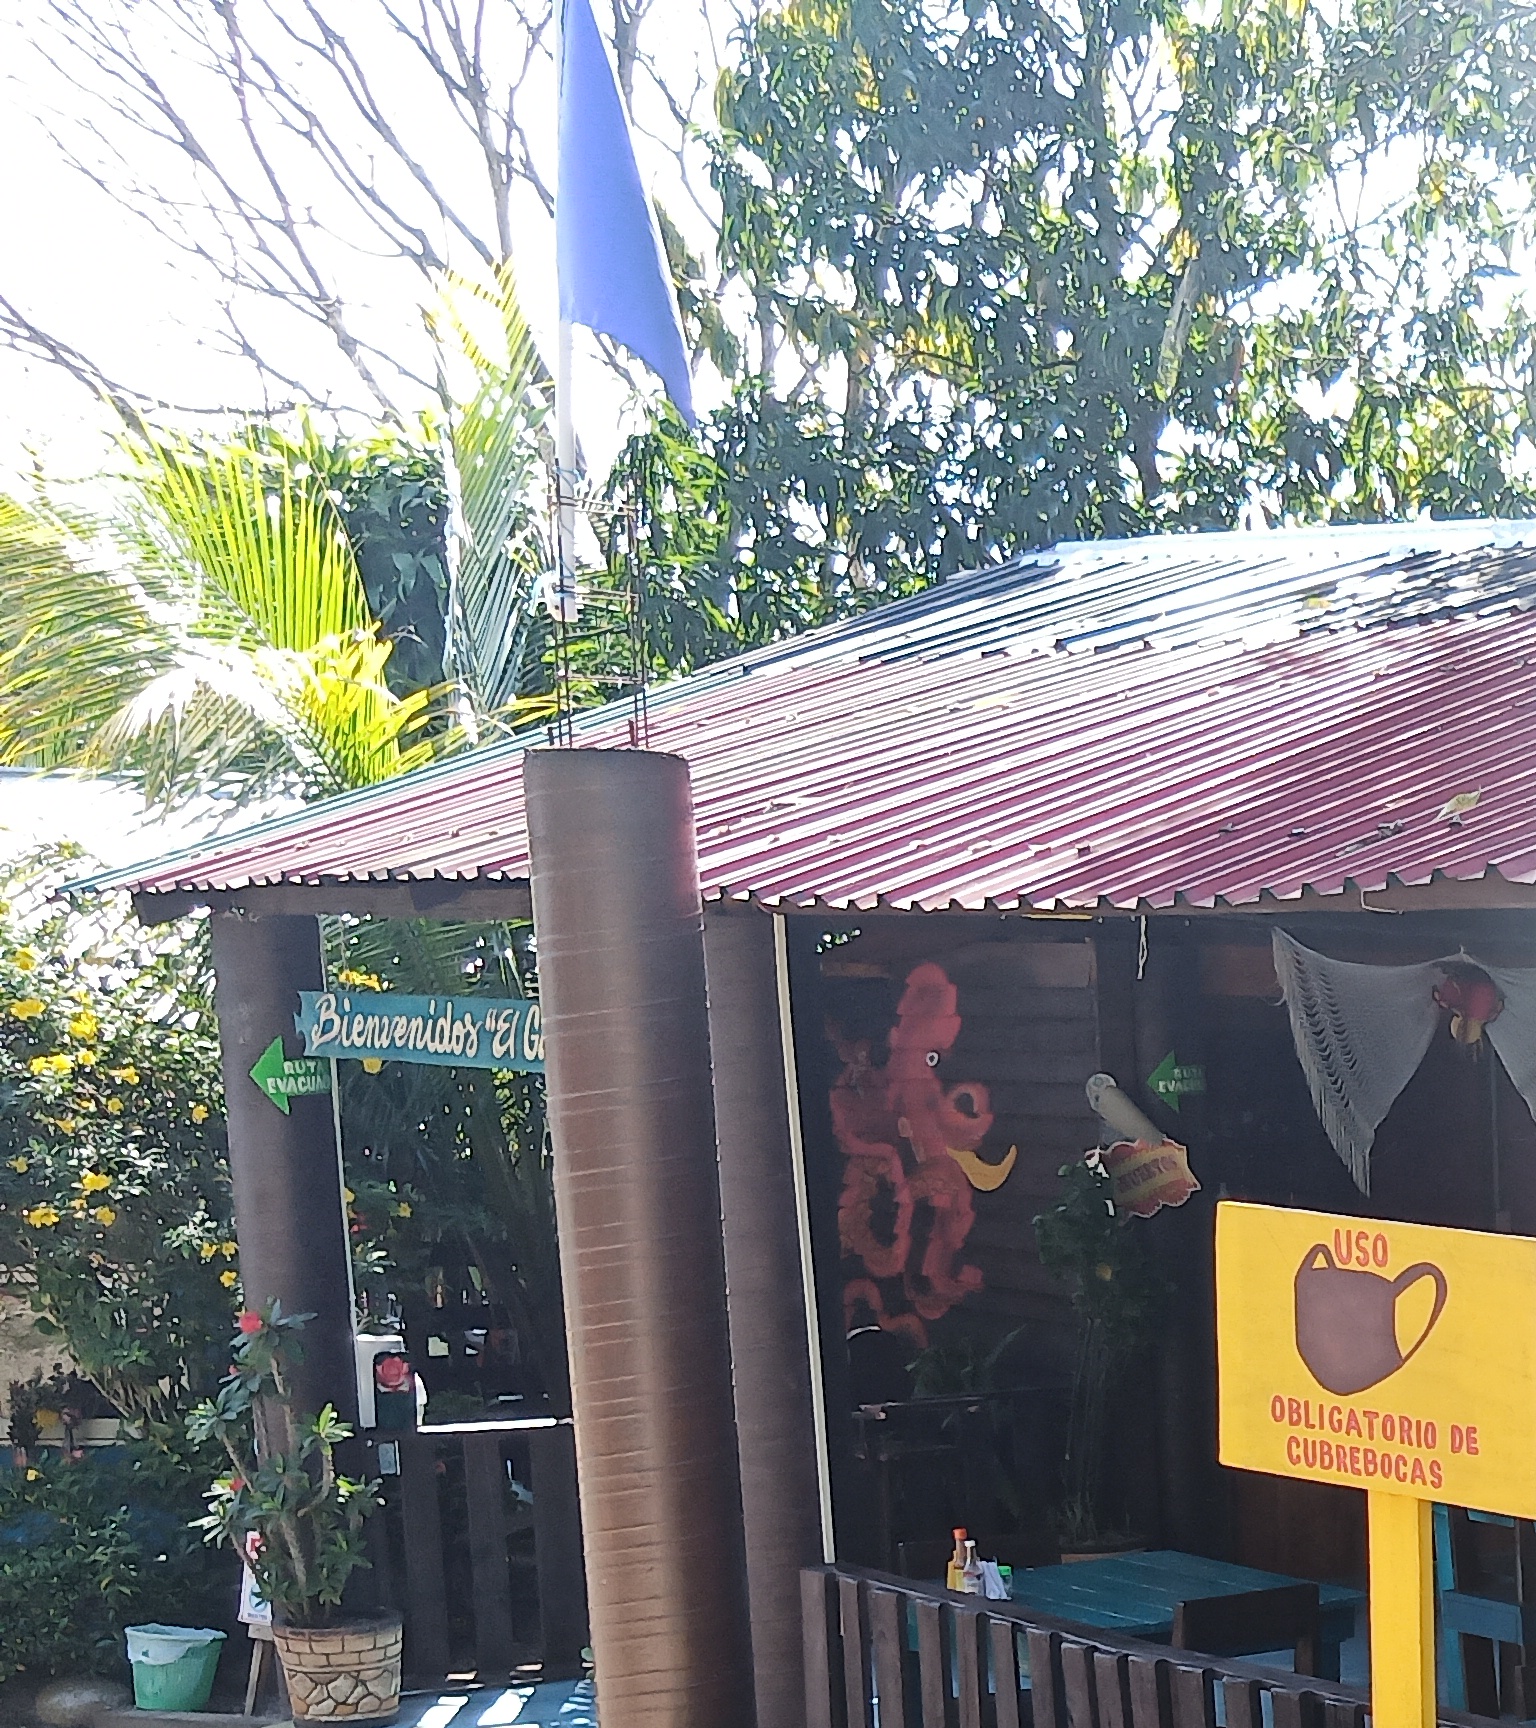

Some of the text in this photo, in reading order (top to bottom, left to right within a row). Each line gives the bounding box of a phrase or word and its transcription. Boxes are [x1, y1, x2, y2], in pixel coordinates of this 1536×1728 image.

[311, 993, 482, 1058] Bienvenidos
[1333, 1228, 1389, 1268] USO
[1271, 1395, 1480, 1456] OBLIGATORIO DE
[1286, 1435, 1443, 1490] CUBREBOCAS
